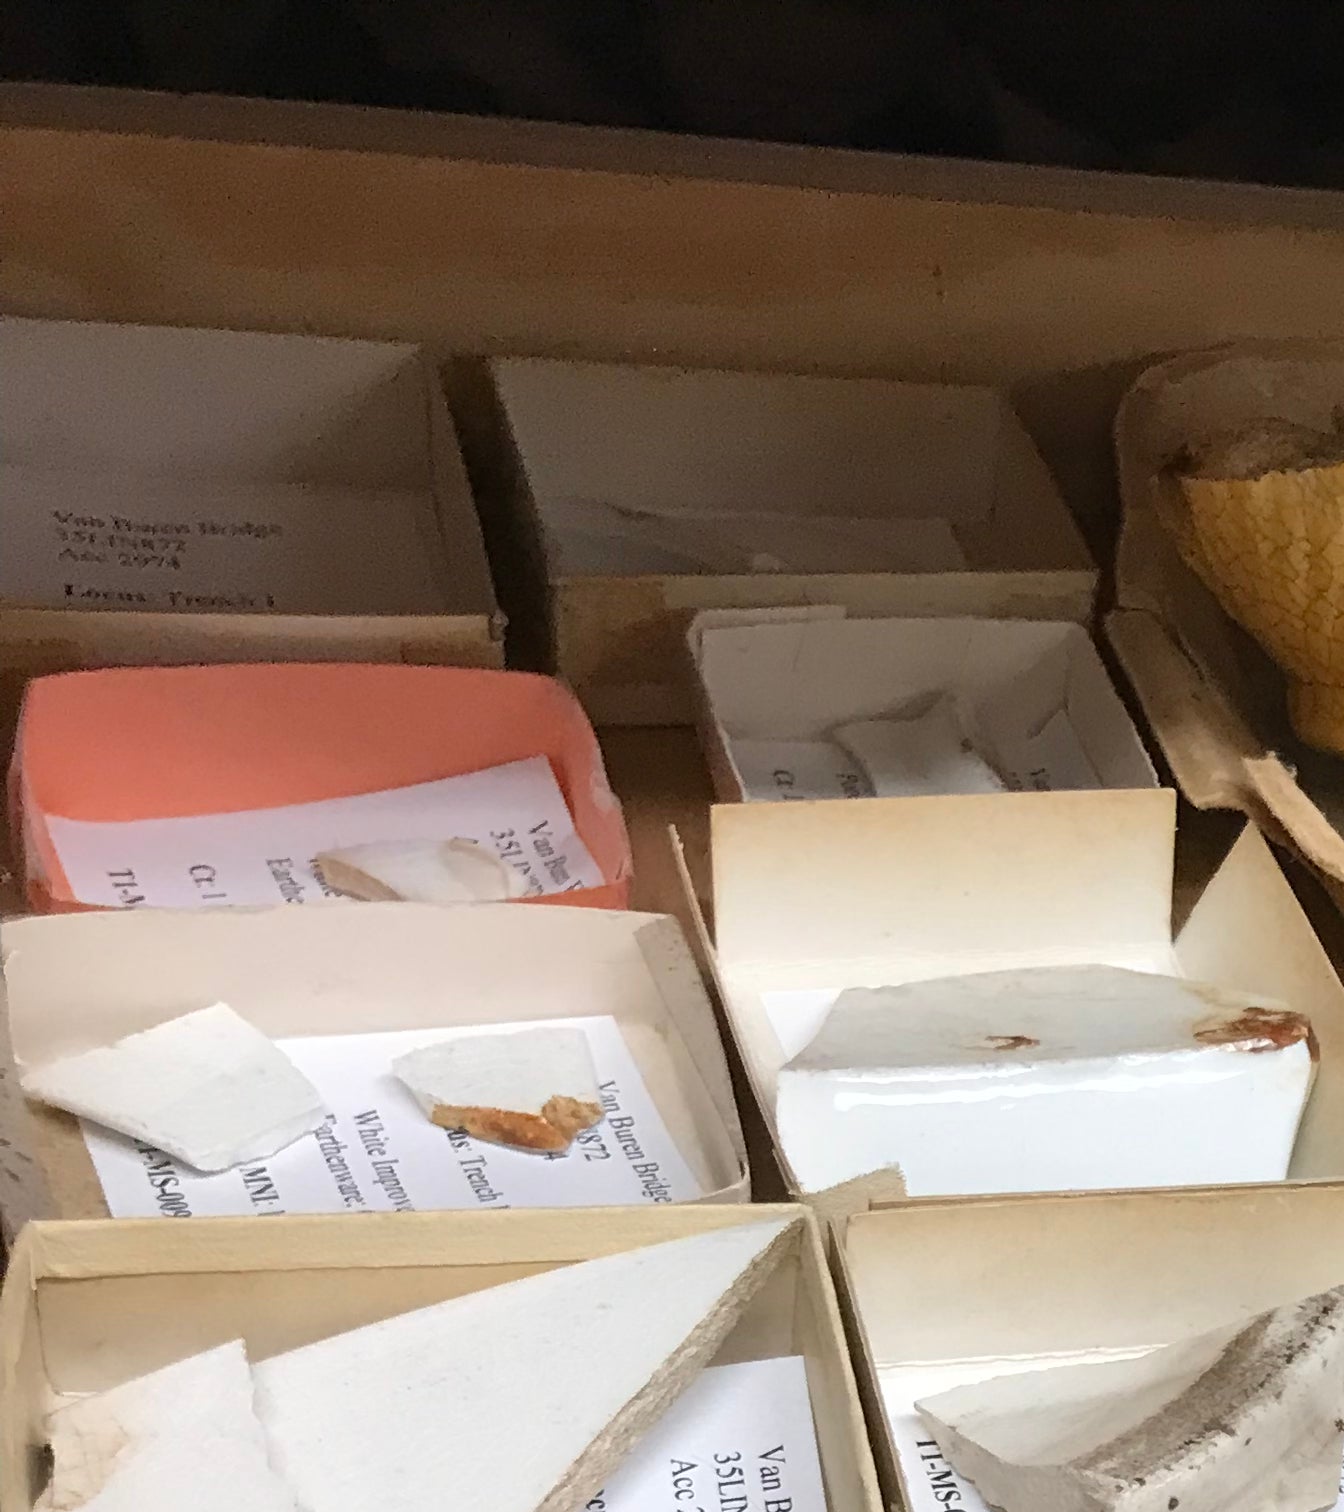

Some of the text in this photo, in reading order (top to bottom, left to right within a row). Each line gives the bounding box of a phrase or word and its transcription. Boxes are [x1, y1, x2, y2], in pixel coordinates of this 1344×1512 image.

[353, 1109, 389, 1157] White
[599, 1079, 673, 1204] Van Buren Bridge
[458, 1154, 504, 1203] Trench
[669, 1458, 700, 1501] Acc
[757, 1444, 786, 1492] Van
